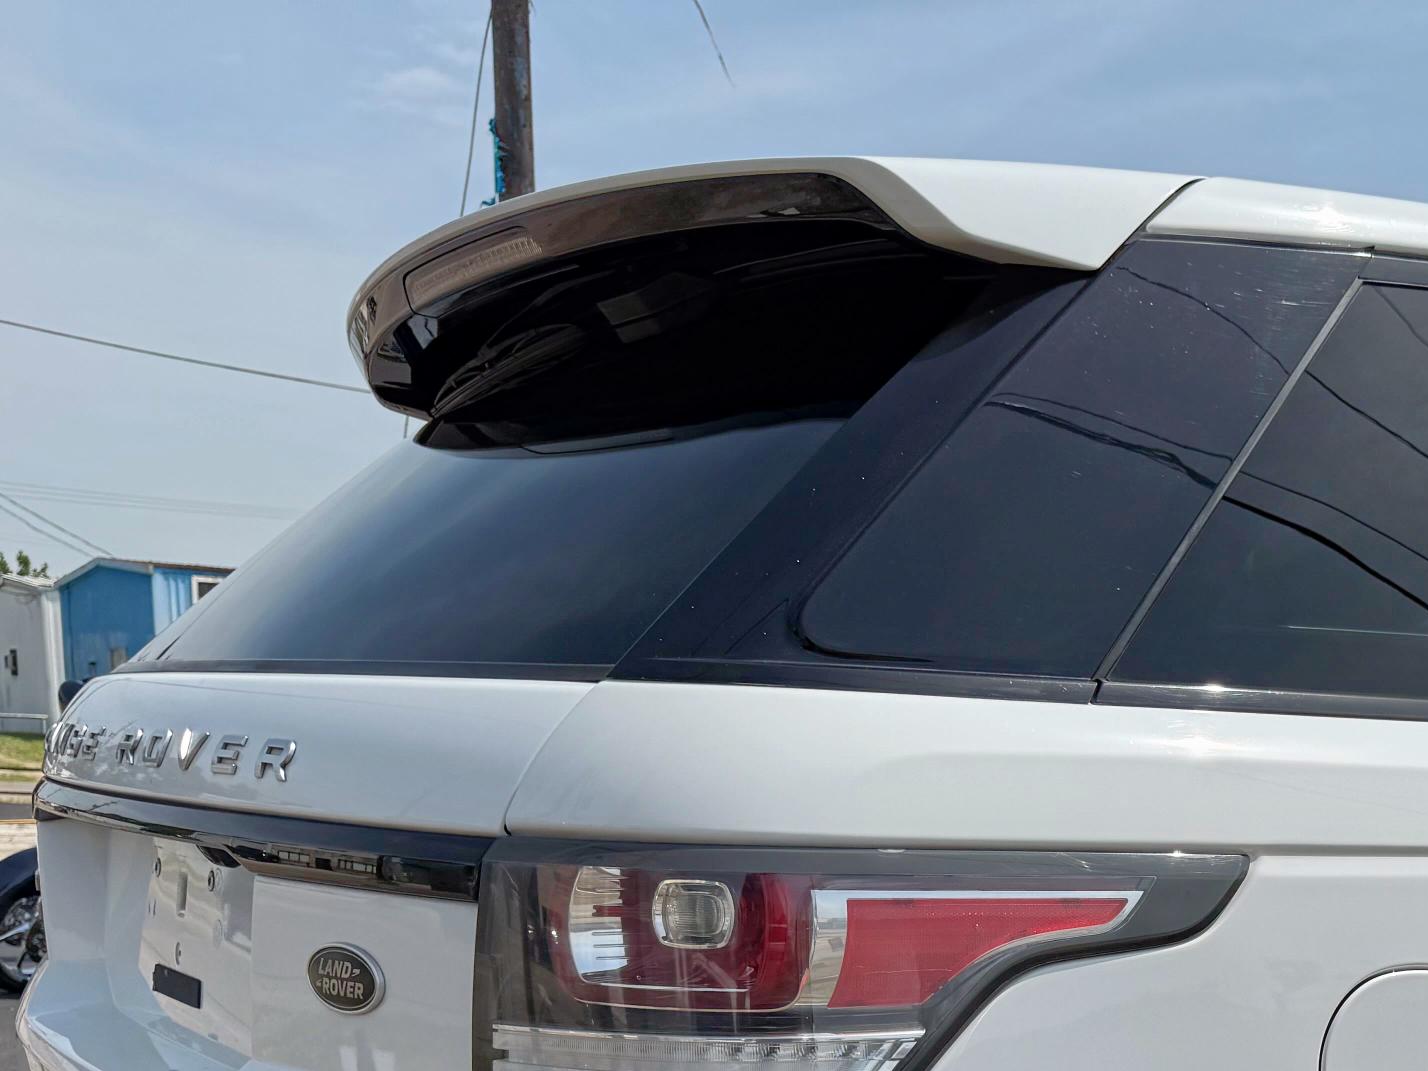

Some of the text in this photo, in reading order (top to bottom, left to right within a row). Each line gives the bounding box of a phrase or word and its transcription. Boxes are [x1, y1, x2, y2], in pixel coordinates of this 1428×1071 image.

[116, 728, 297, 782] ROVER
[319, 958, 352, 979] LAND
[322, 978, 364, 1000] ROVER
